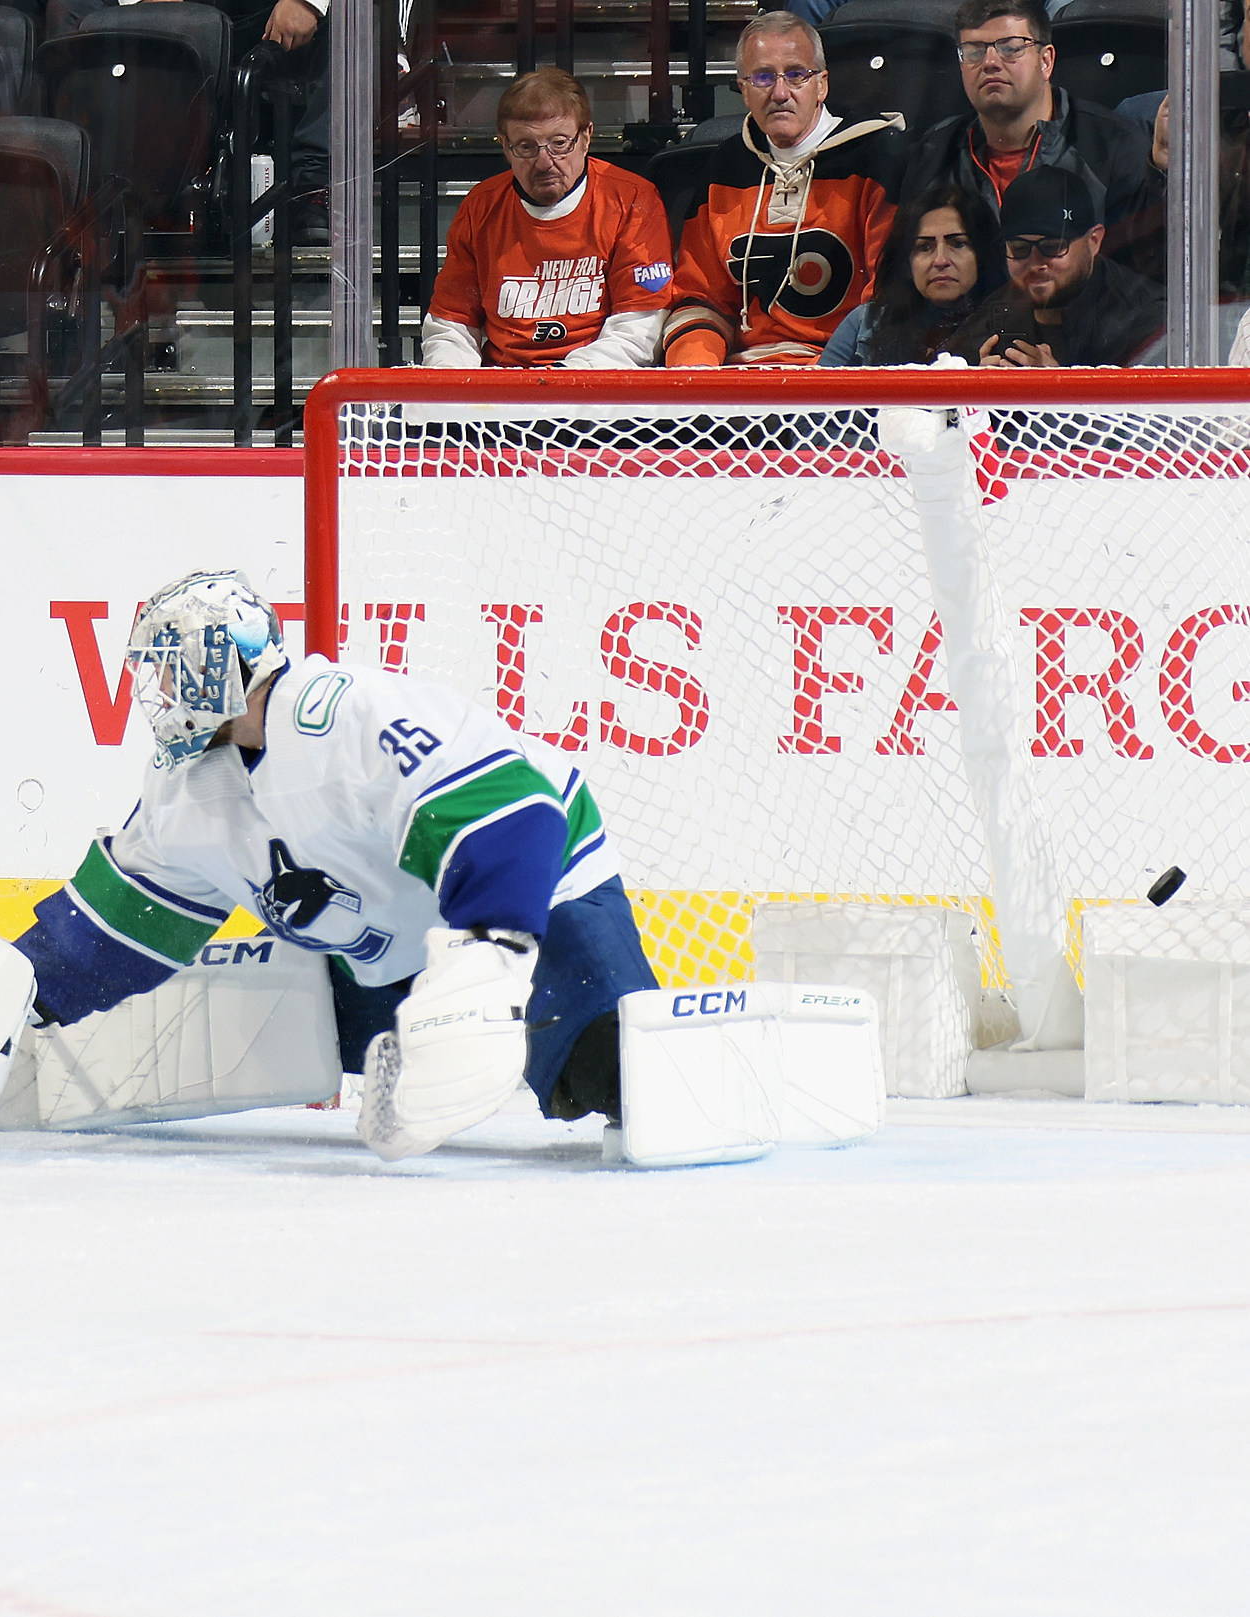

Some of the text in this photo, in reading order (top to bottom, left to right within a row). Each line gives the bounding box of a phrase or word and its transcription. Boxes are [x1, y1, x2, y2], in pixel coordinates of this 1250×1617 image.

[540, 259, 574, 281] NEW
[574, 256, 598, 277] ERA
[497, 276, 606, 319] ORANGE
[378, 718, 443, 778] 35
[185, 940, 275, 966] CM
[672, 989, 747, 1018] CCM
